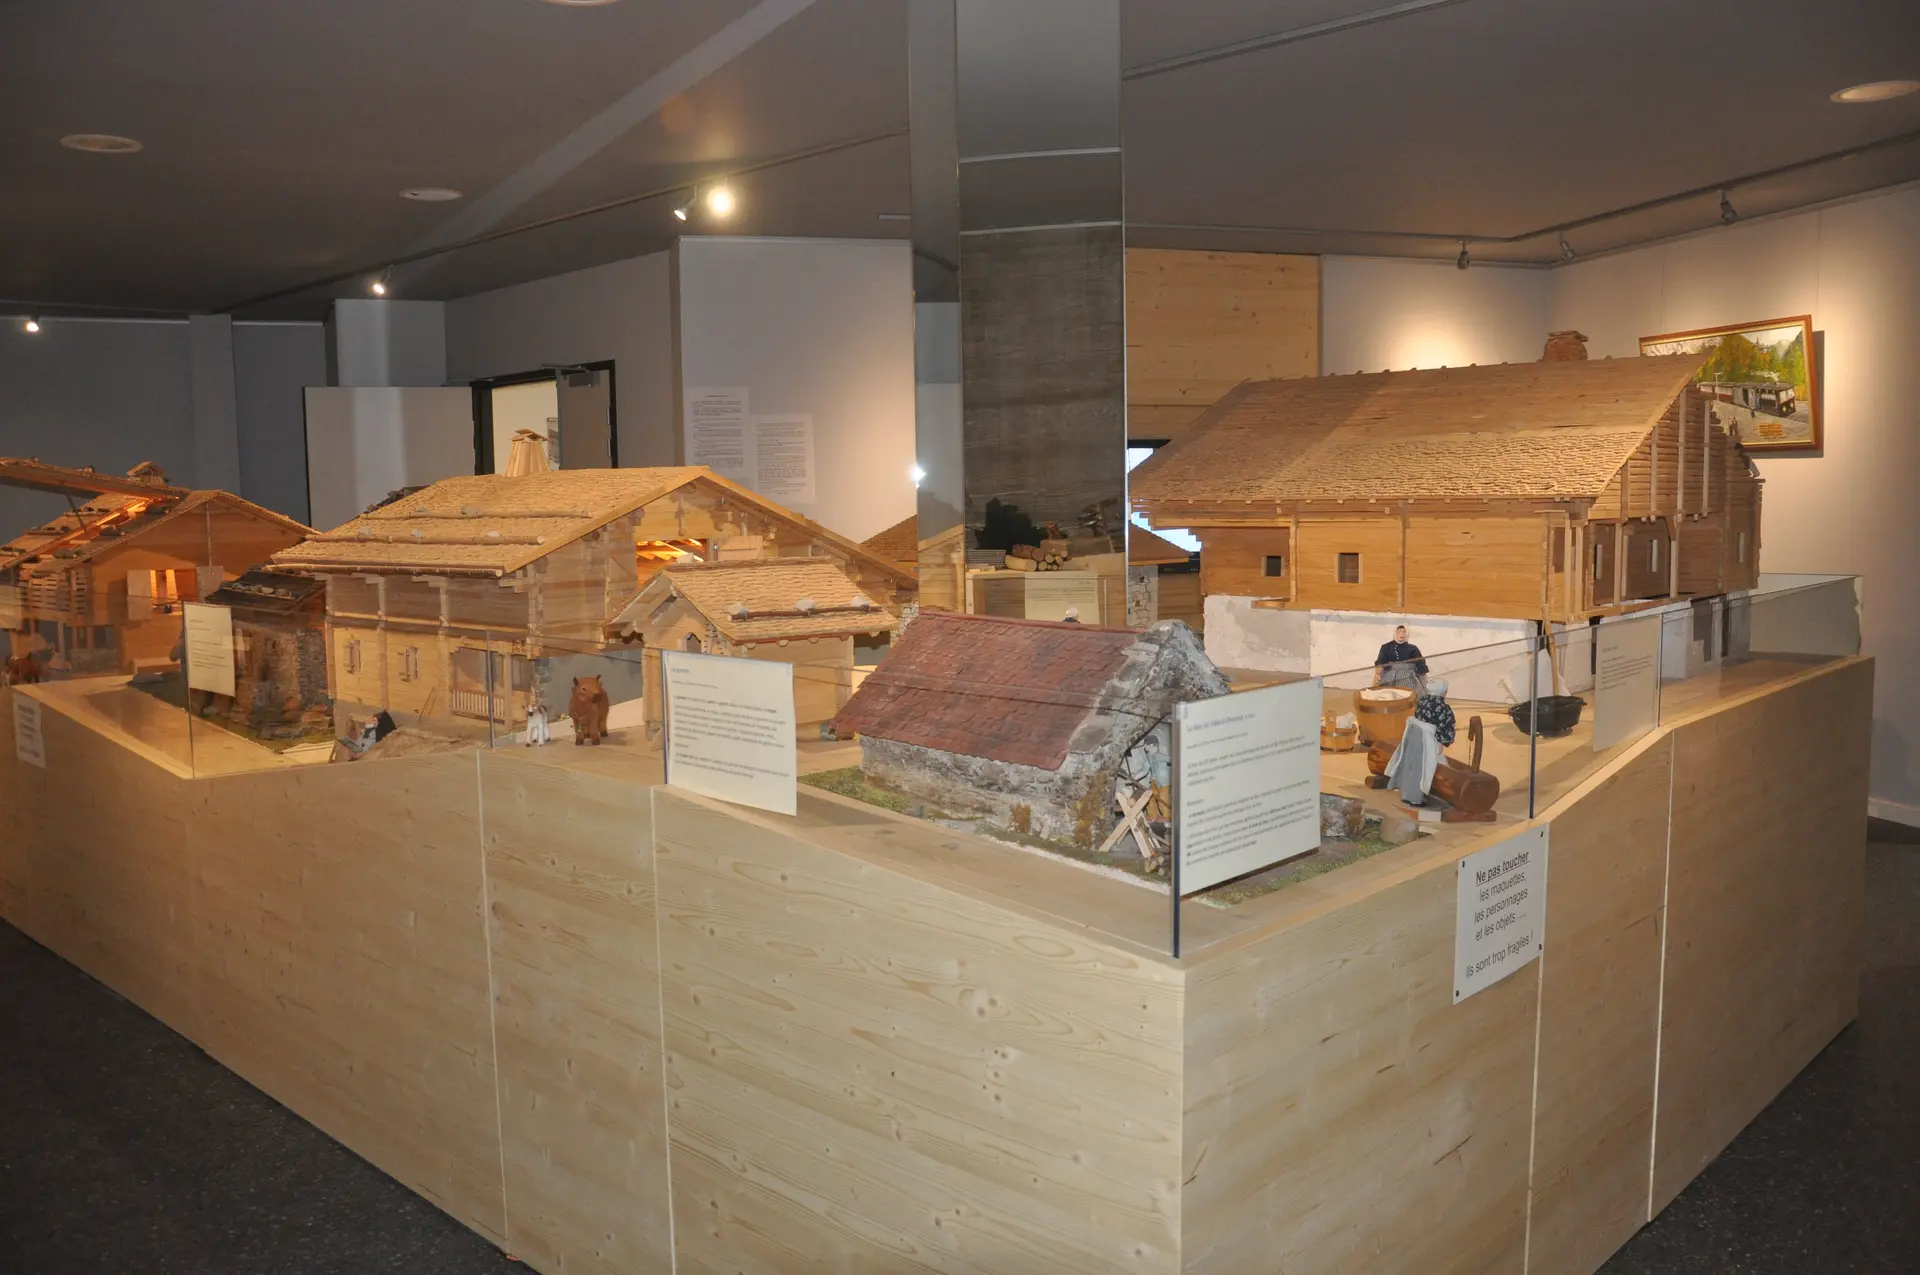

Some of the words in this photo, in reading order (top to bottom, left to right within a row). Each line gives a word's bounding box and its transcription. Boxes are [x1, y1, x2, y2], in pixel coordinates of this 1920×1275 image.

[1476, 870, 1486, 885] Ne
[1488, 865, 1501, 880] pas
[1502, 852, 1530, 872] toucher
[1474, 910, 1485, 925] les
[1486, 888, 1528, 920] personnages
[1479, 889, 1489, 902] les
[1475, 928, 1483, 941] et
[1484, 923, 1494, 936] les
[1495, 912, 1516, 931] objets
[1475, 954, 1491, 973] sont
[1492, 948, 1506, 964] trop
[1507, 935, 1530, 956] fragiles
